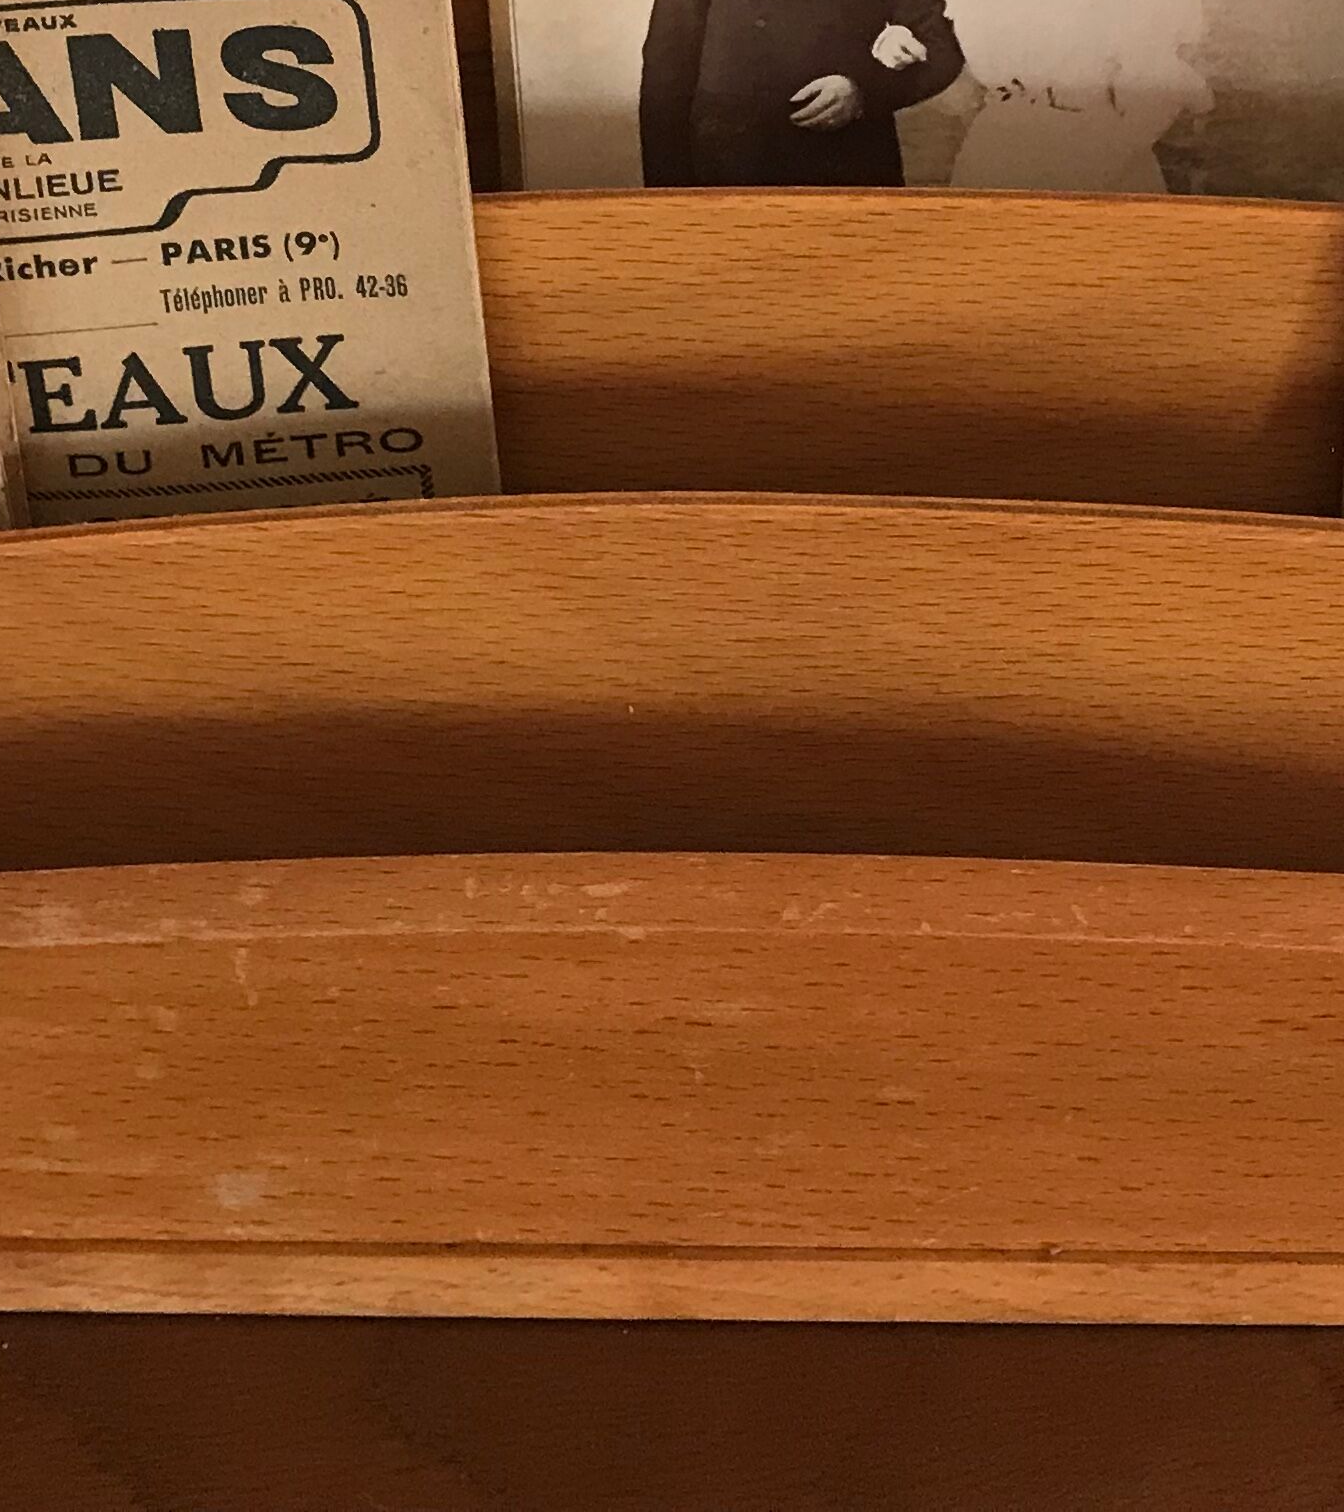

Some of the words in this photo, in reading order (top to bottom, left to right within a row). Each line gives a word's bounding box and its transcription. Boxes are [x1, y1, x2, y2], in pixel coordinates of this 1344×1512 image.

[25, 152, 53, 167] LA
[160, 234, 272, 266] PARIS
[159, 283, 268, 315] Téléphoner
[278, 278, 292, 303] à
[298, 276, 345, 302] PRO.
[355, 273, 409, 299] 42-36
[7, 332, 360, 435] EAUX
[67, 449, 153, 479] DU
[199, 426, 425, 470] MÉTRO
